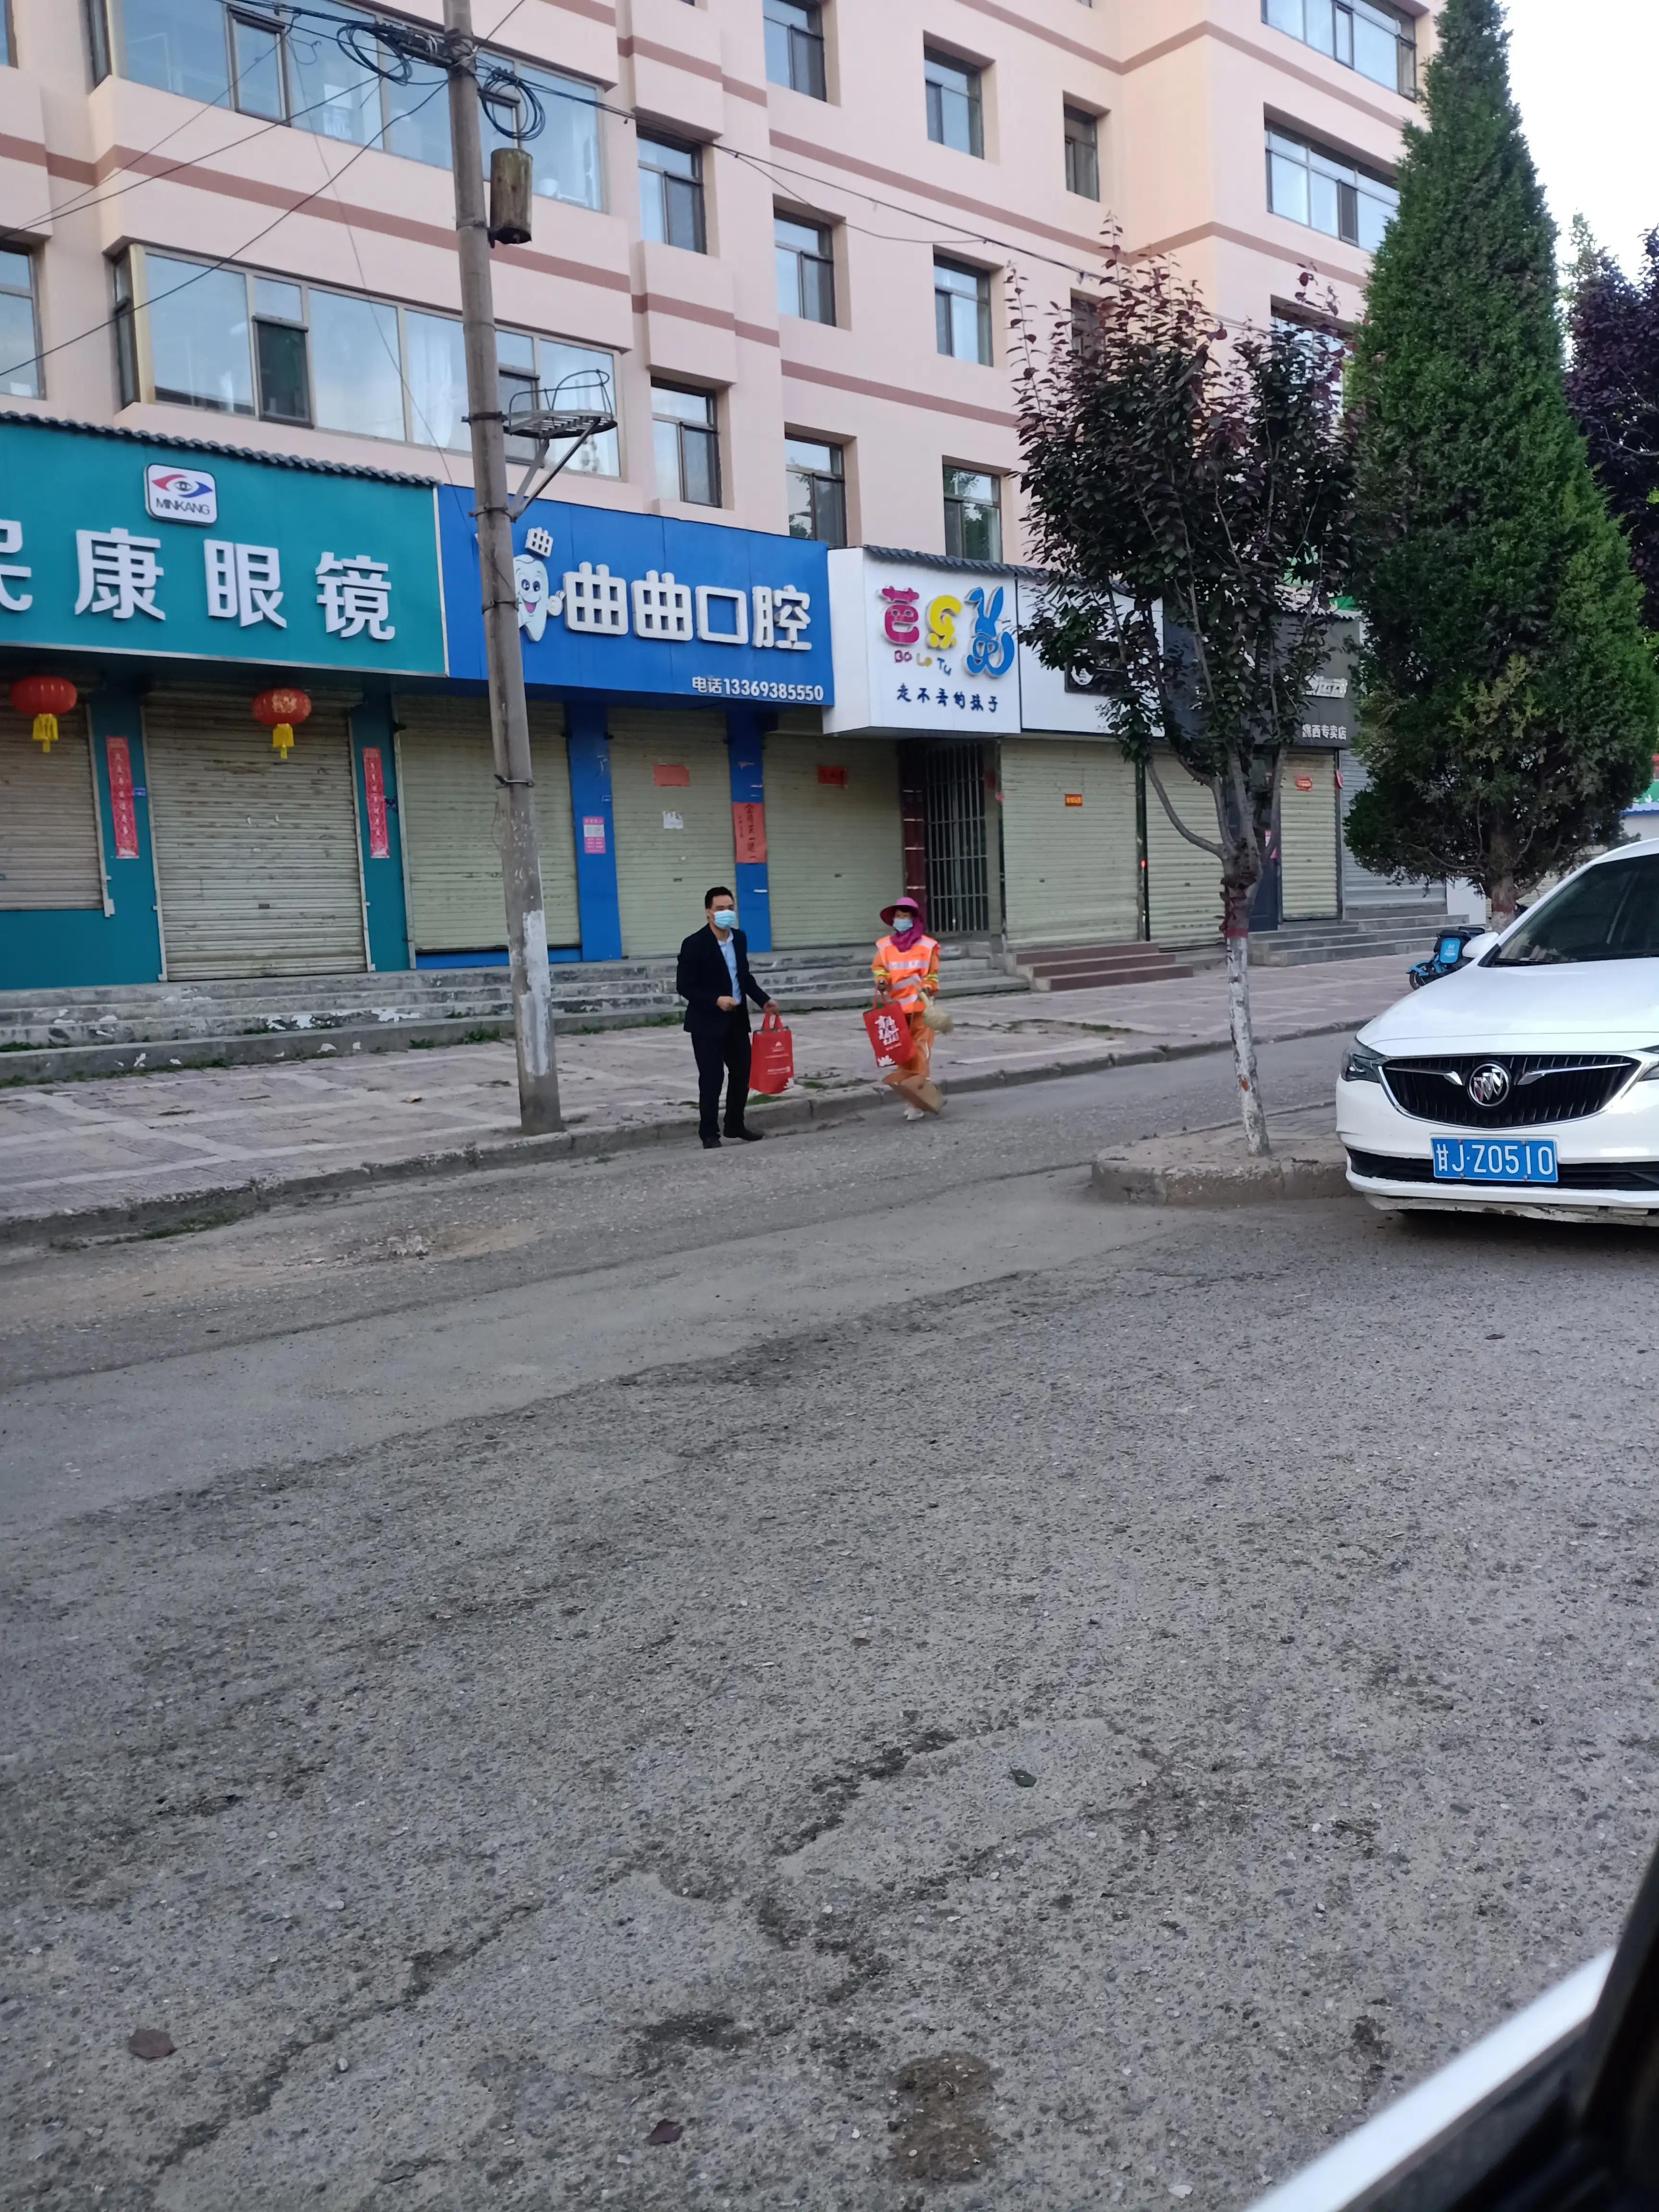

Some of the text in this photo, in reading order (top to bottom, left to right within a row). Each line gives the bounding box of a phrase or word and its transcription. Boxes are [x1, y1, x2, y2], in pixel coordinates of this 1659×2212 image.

[156, 497, 210, 515] MINKANG
[563, 561, 812, 650] 曲曲口腔
